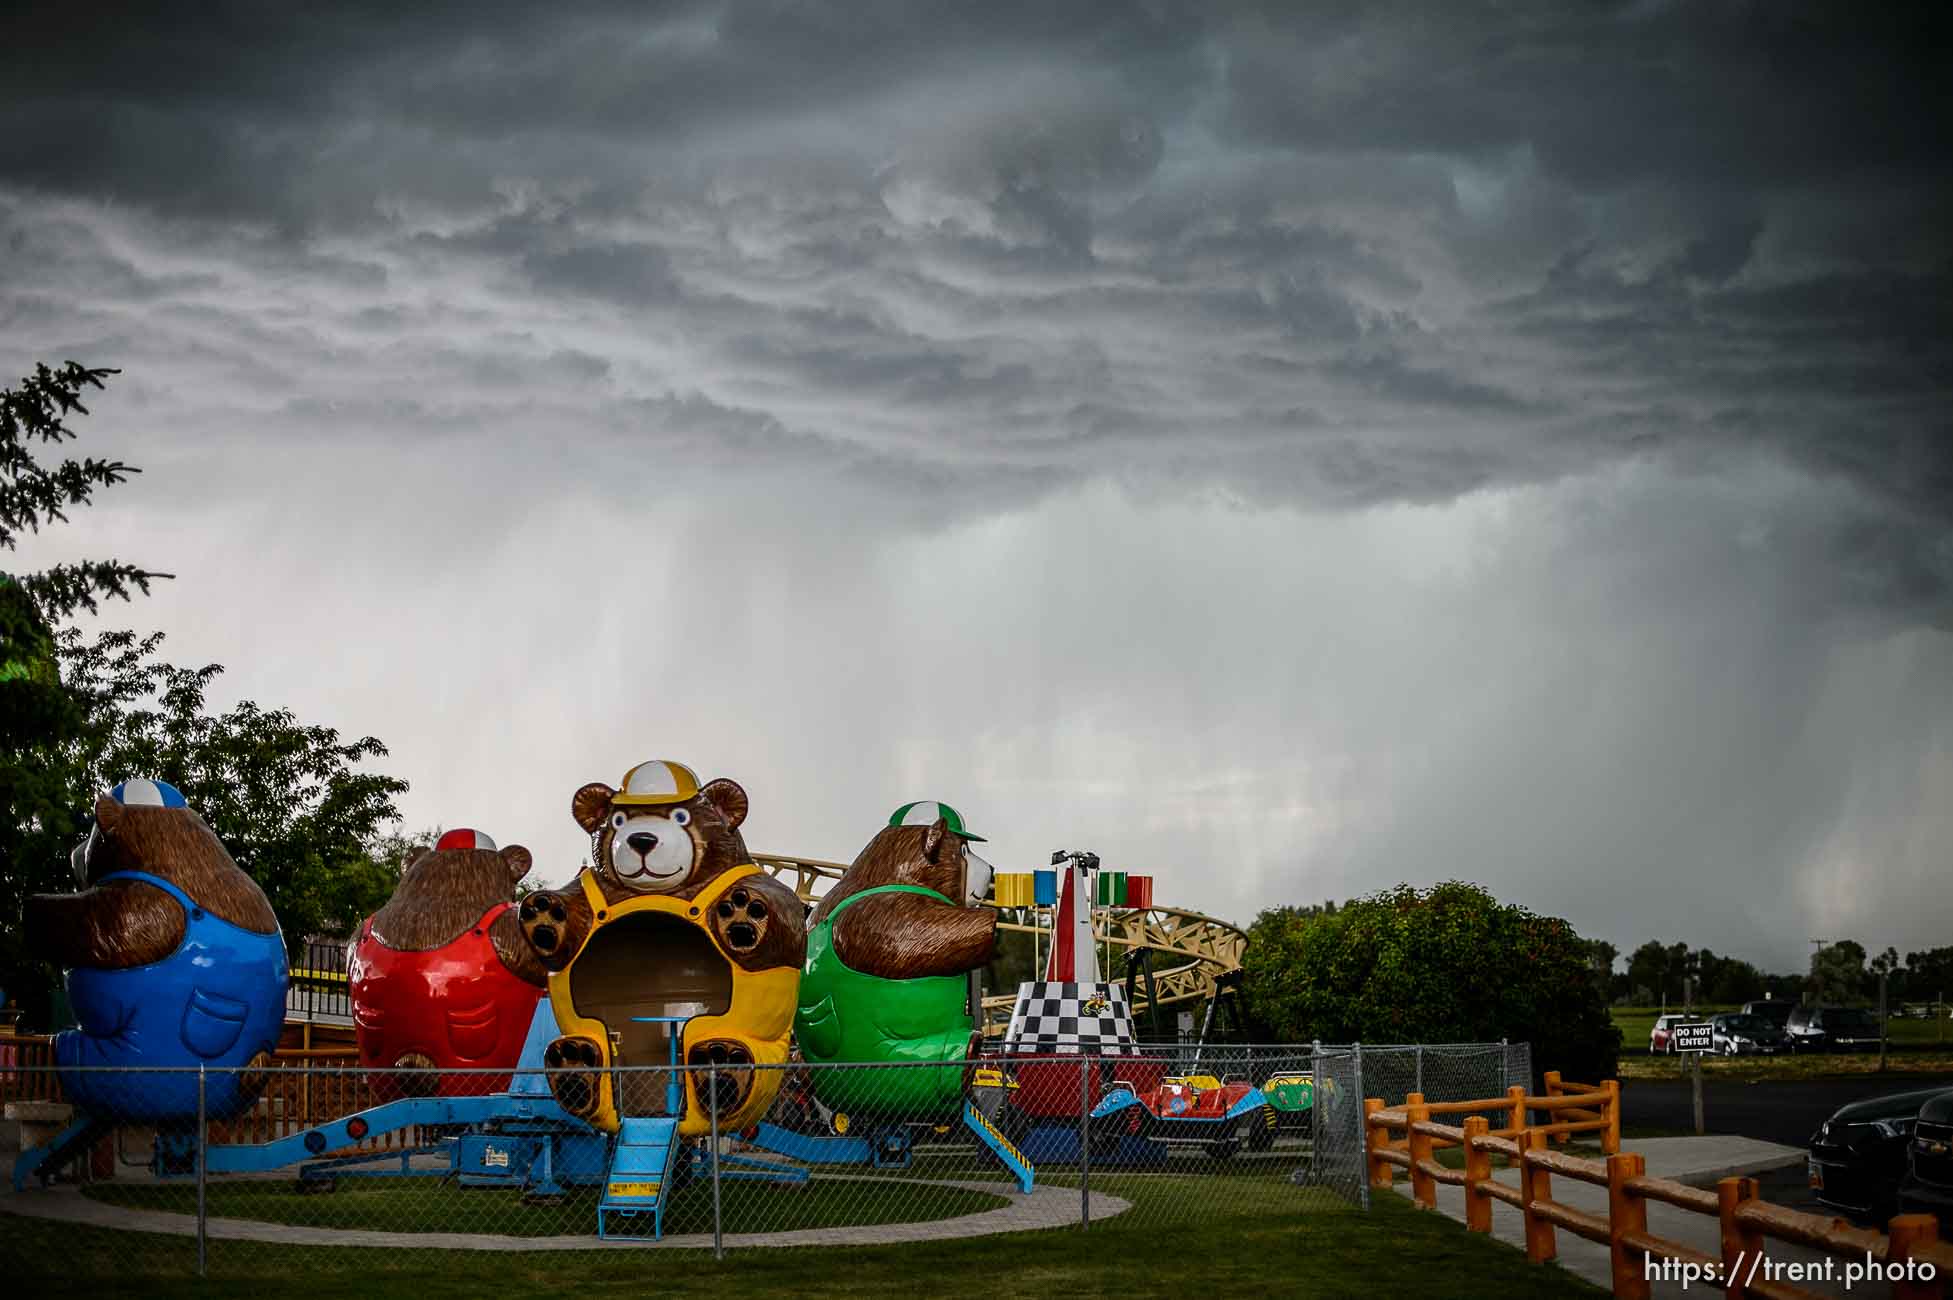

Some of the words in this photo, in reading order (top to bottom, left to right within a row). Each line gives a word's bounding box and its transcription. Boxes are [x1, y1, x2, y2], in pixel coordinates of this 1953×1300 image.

[1677, 1028, 1690, 1037] DO
[1693, 1027, 1711, 1036] NOT
[1680, 1037, 1710, 1046] ENTER
